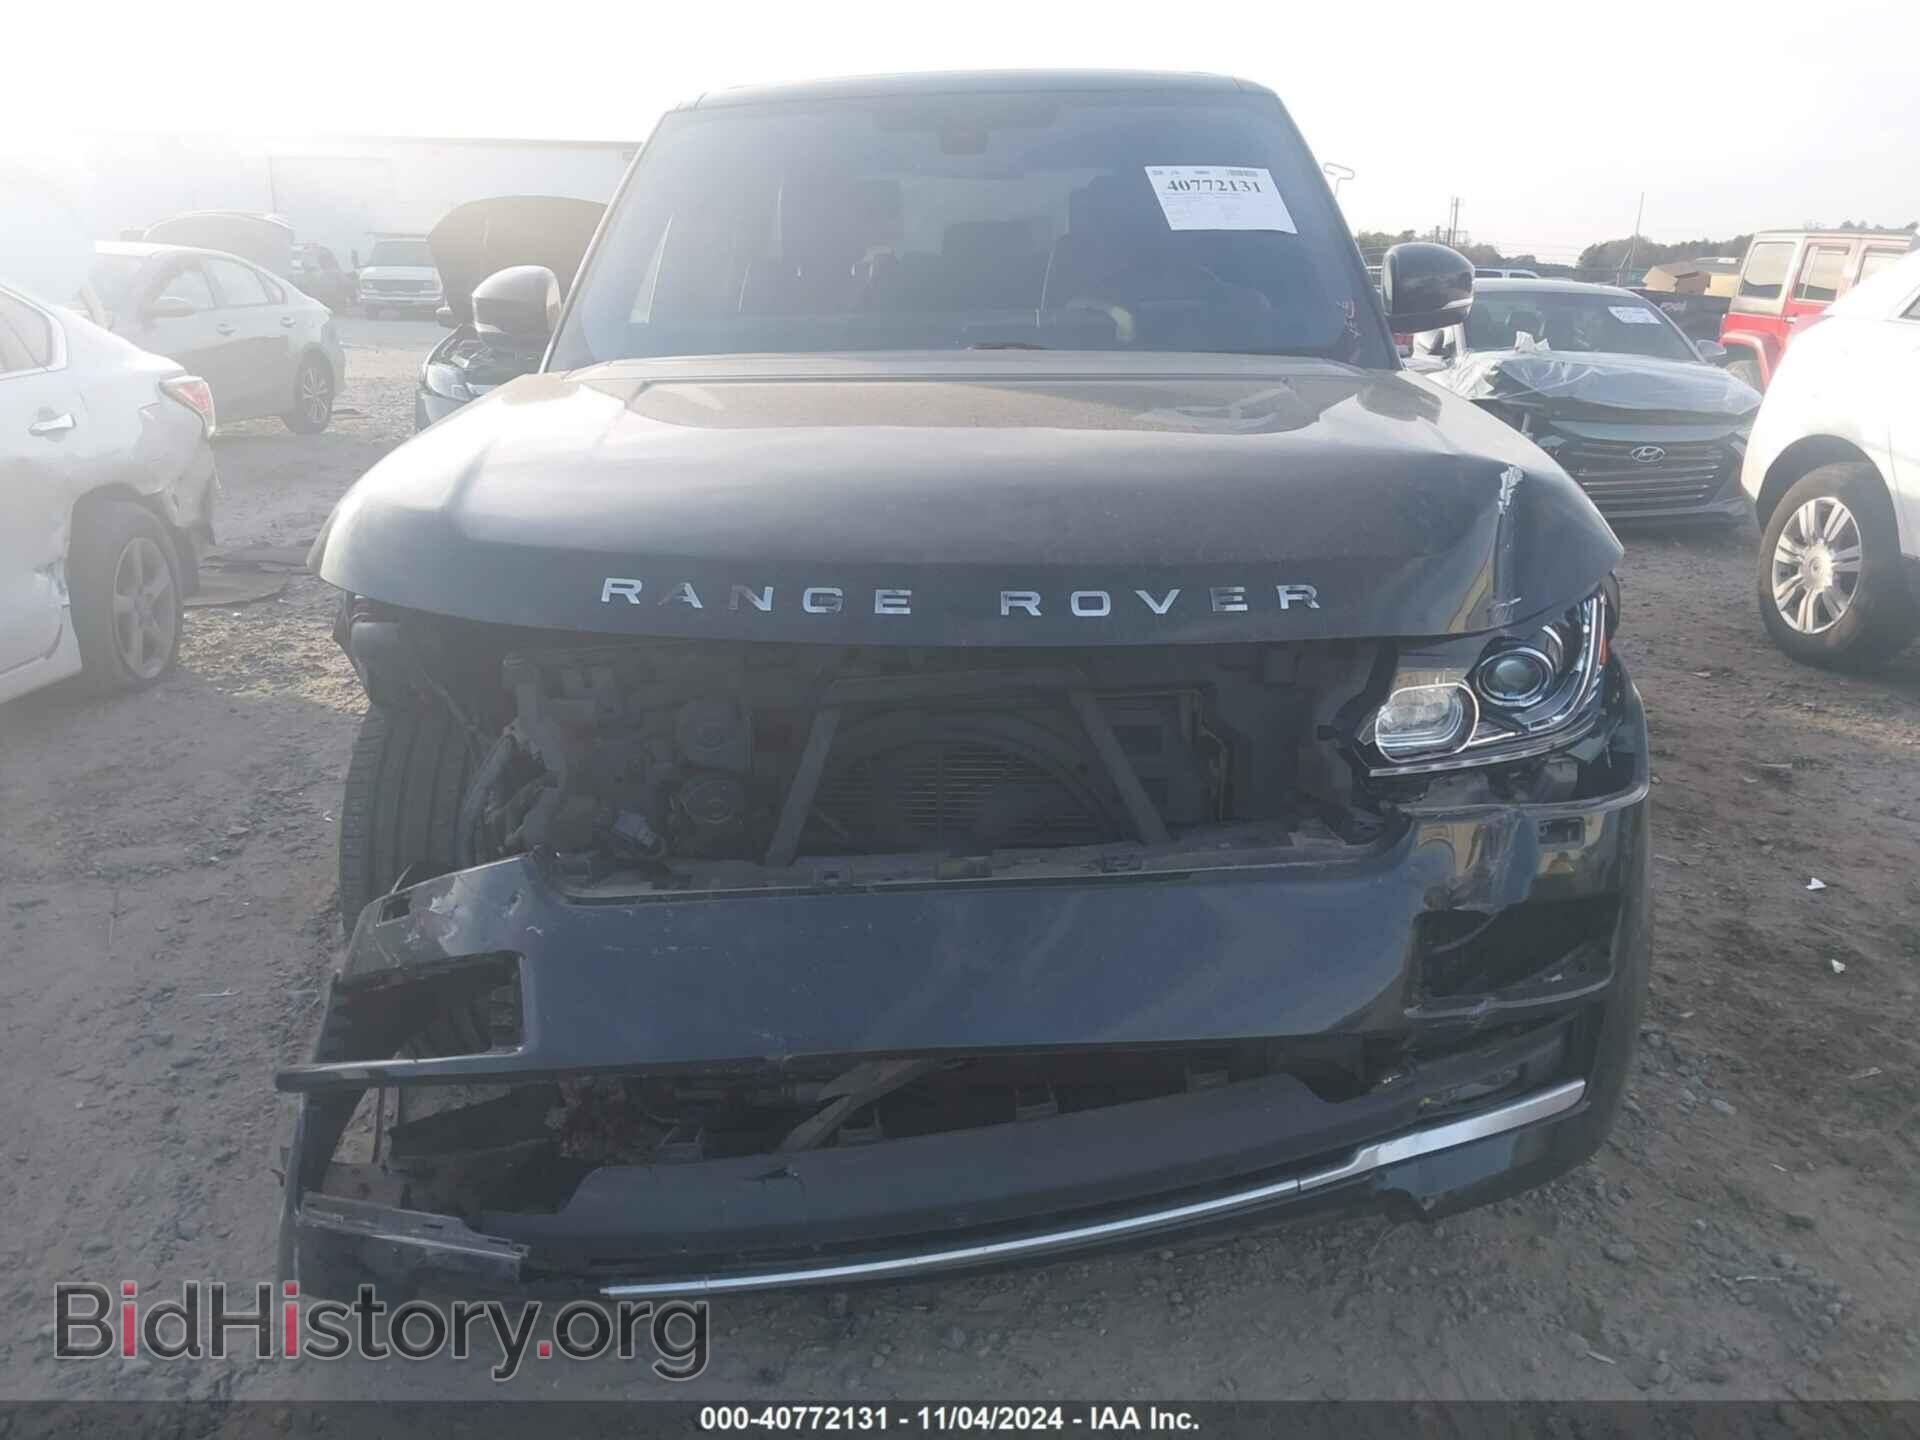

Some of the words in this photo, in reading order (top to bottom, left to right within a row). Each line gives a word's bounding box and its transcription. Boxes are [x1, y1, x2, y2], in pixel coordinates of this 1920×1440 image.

[1167, 178, 1262, 193] 40772131
[601, 577, 913, 614] RANGE
[1000, 584, 1321, 617] ROVER
